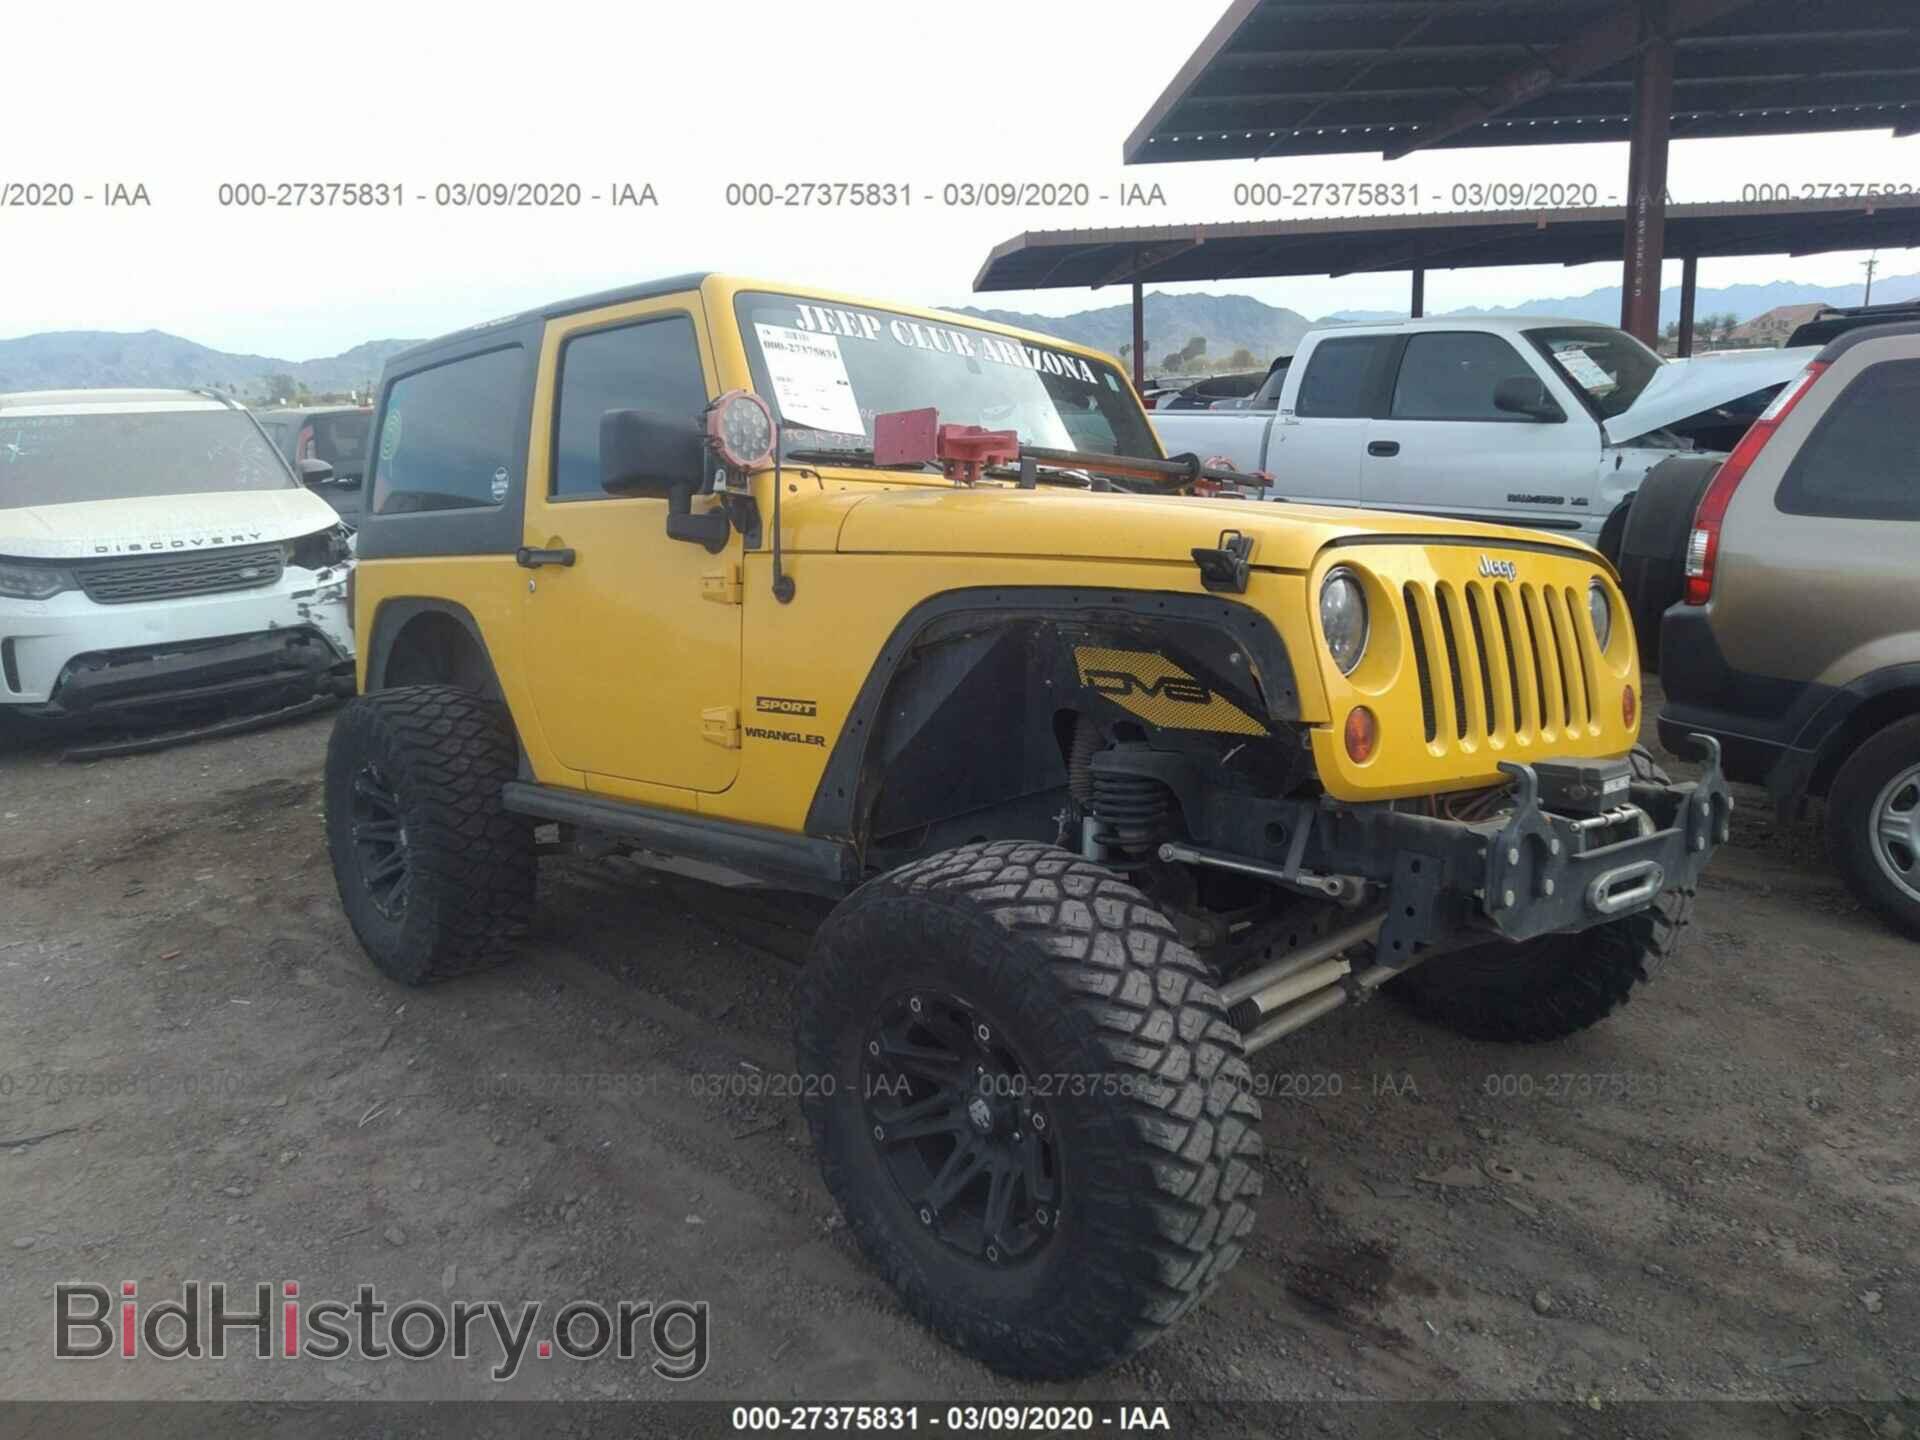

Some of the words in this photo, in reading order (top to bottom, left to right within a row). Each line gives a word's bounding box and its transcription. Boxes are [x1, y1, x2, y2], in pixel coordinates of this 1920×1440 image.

[795, 304, 882, 341] JEEP
[889, 319, 977, 359] CLUB
[984, 337, 1098, 384] ARIZONA
[95, 532, 262, 554] DISCOVERY
[1478, 553, 1517, 583] Jeep
[758, 698, 817, 715] SPORT
[744, 726, 827, 748] WRANGLER
